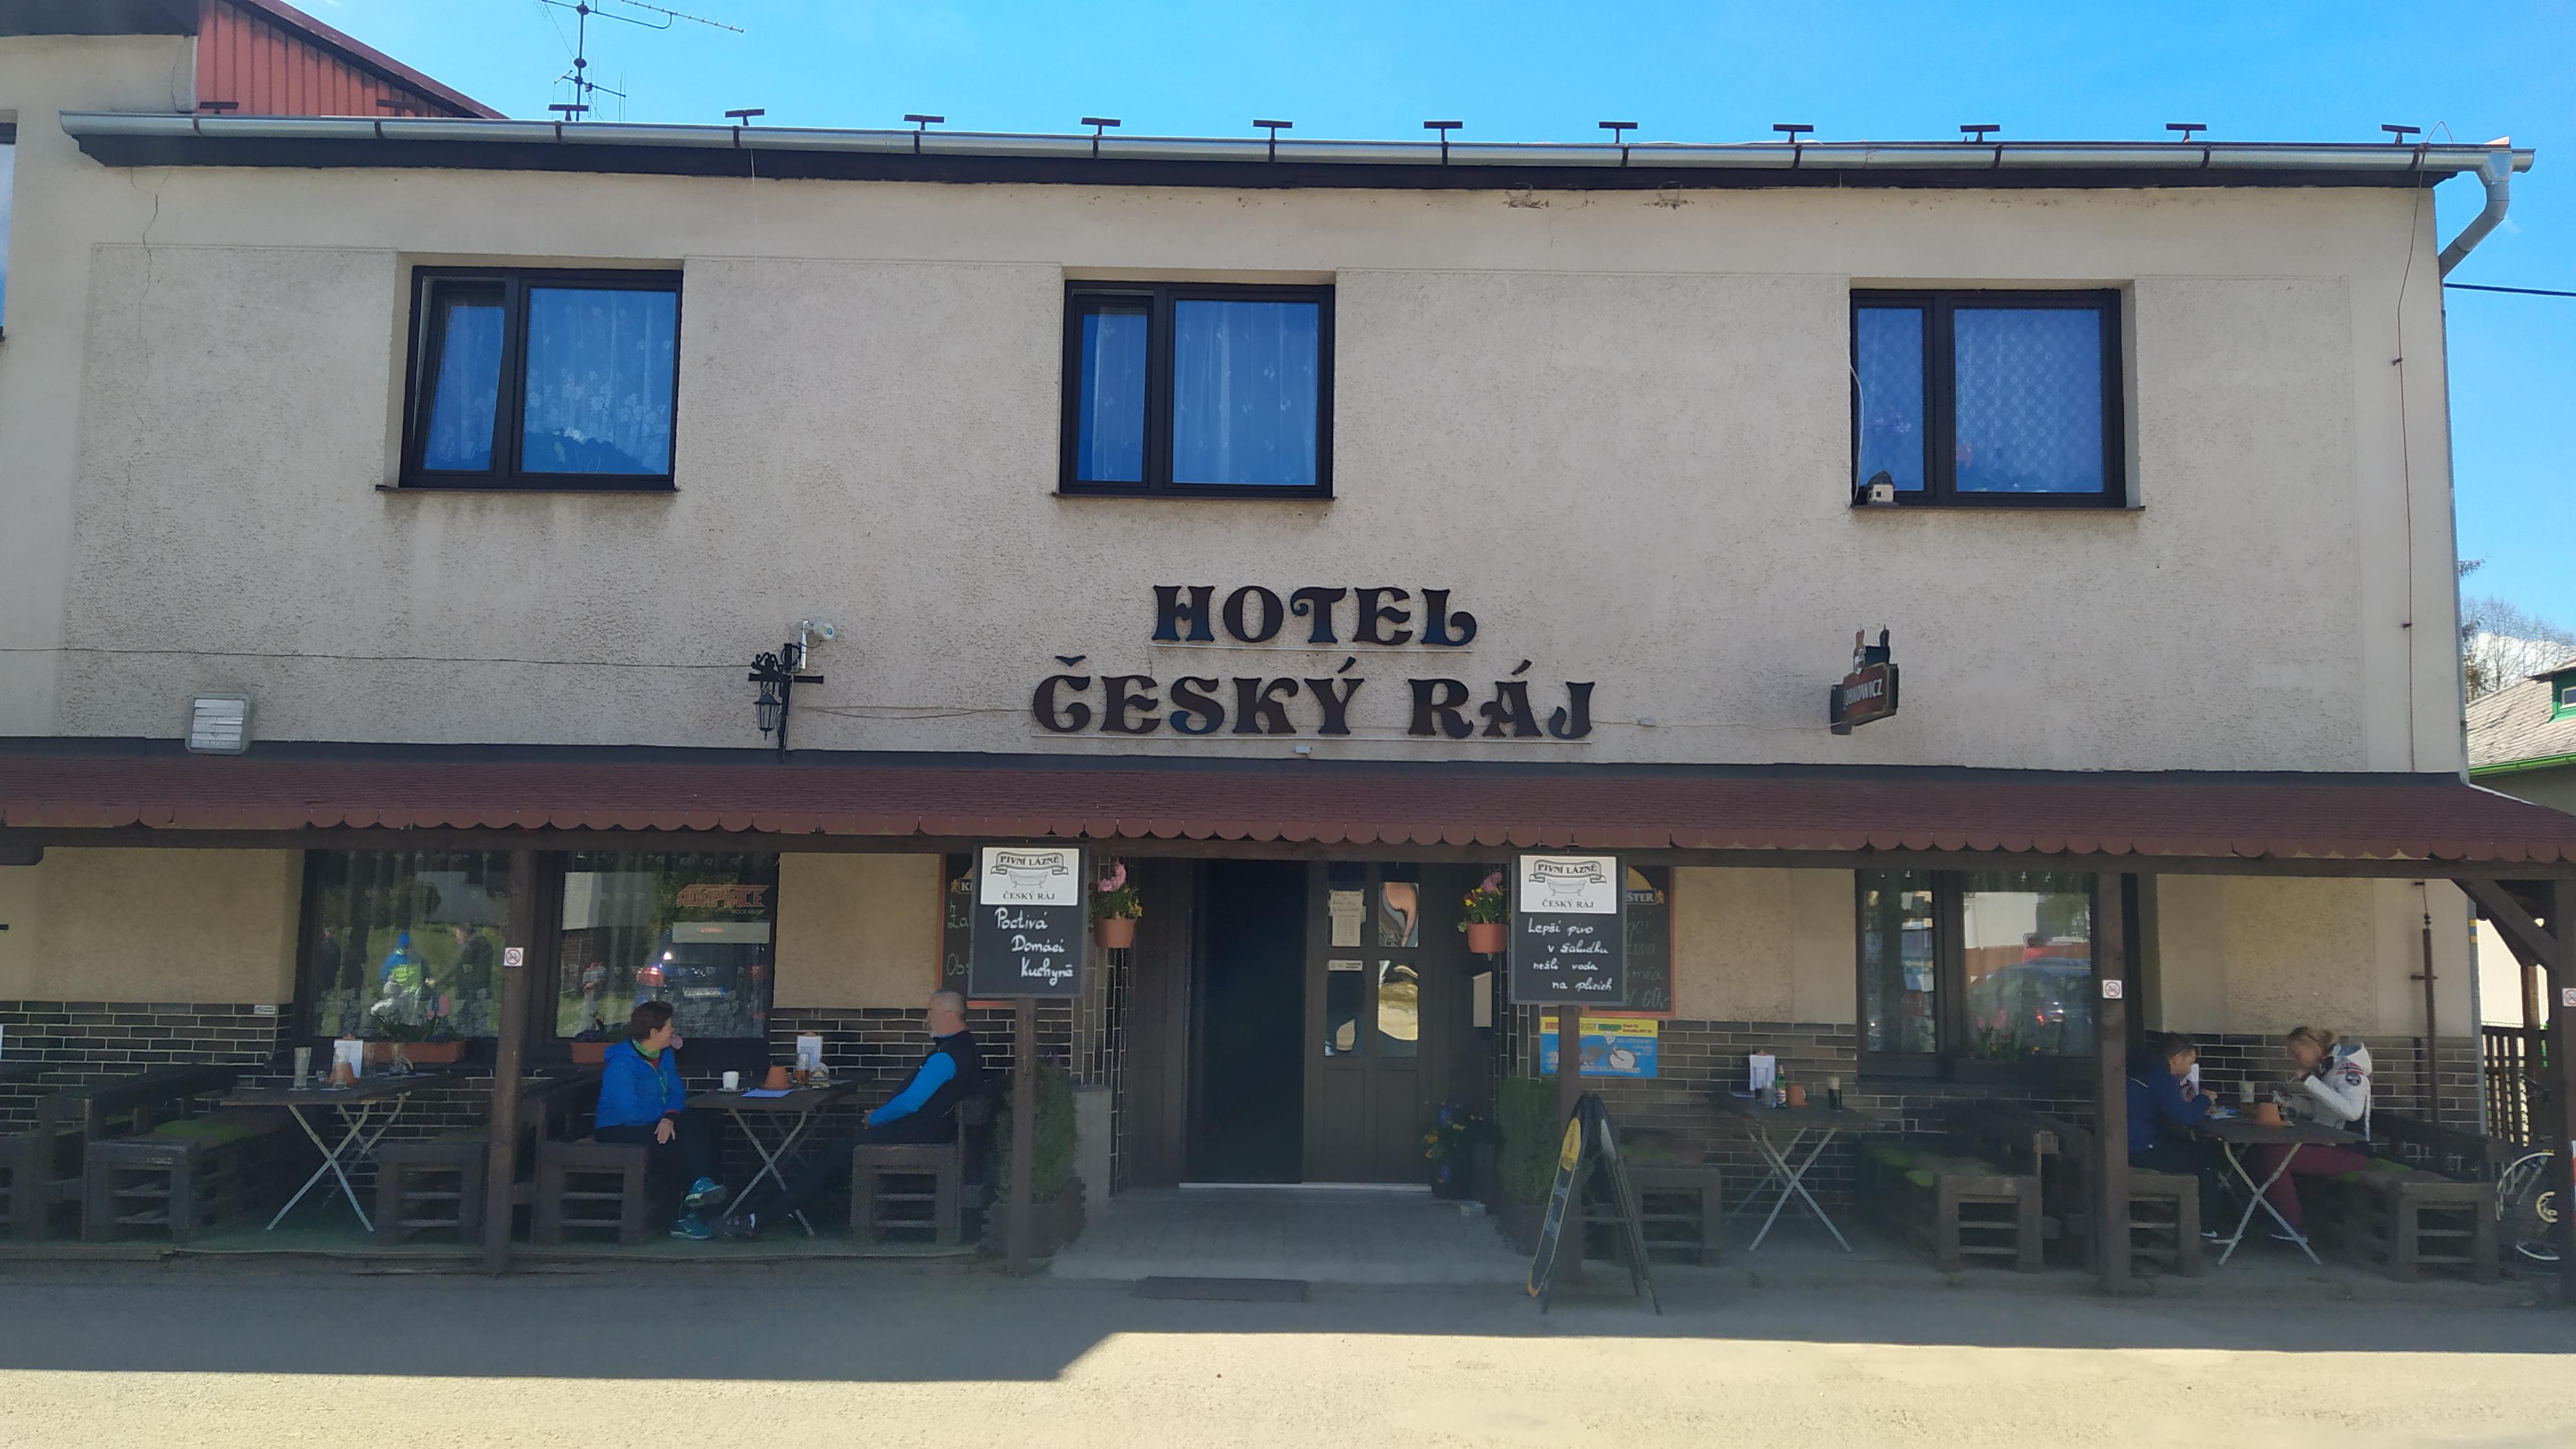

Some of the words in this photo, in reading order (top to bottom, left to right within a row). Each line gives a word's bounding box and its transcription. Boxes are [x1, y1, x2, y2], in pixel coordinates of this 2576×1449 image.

[1152, 585, 1477, 645] HOTEL
[1032, 655, 1365, 736] ČESKÝ
[1408, 659, 1596, 740] RÁJ
[999, 855, 1026, 865] PIVNÍ
[1028, 855, 1060, 866] LÁZNĚ
[1537, 864, 1564, 873] PIVNÍ
[1566, 864, 1598, 874] LÁZNĚ
[1002, 891, 1035, 900] ČESKÝ
[1037, 891, 1056, 900] RÁJ
[1541, 898, 1573, 908] ČESKÝ
[1577, 899, 1595, 909] RÁJ
[994, 907, 1048, 930] Poctivá
[1528, 917, 1562, 936] Lepší
[1567, 923, 1594, 936] pivo
[1010, 934, 1066, 952] Domácí
[1547, 944, 1555, 953] v
[1021, 956, 1074, 986] Kuchyně
[1533, 957, 1560, 971] nežli
[1571, 961, 1598, 971] voda
[1551, 981, 1568, 990] na
